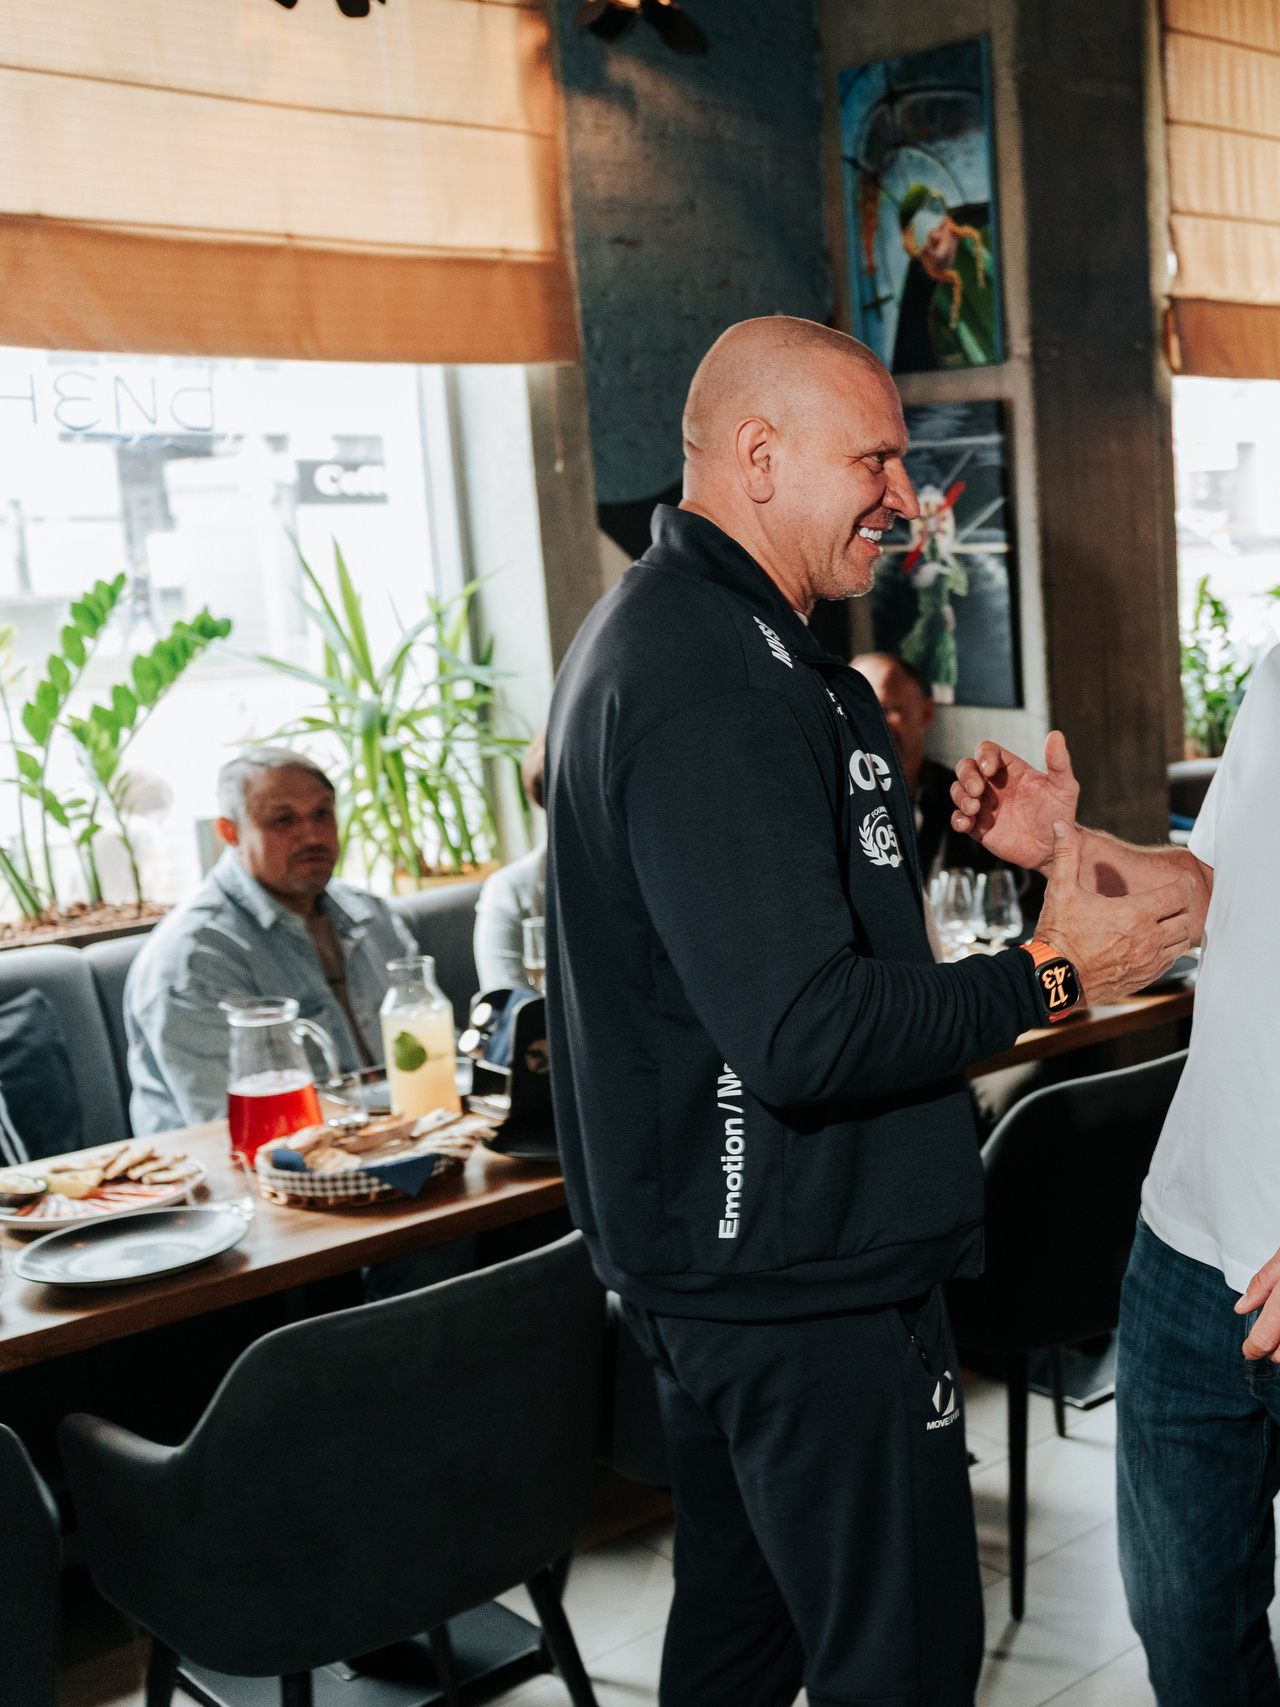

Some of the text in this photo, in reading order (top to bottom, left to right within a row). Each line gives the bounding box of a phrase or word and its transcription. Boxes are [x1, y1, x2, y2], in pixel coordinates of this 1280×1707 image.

[716, 1062, 746, 1239] Emotion / M
